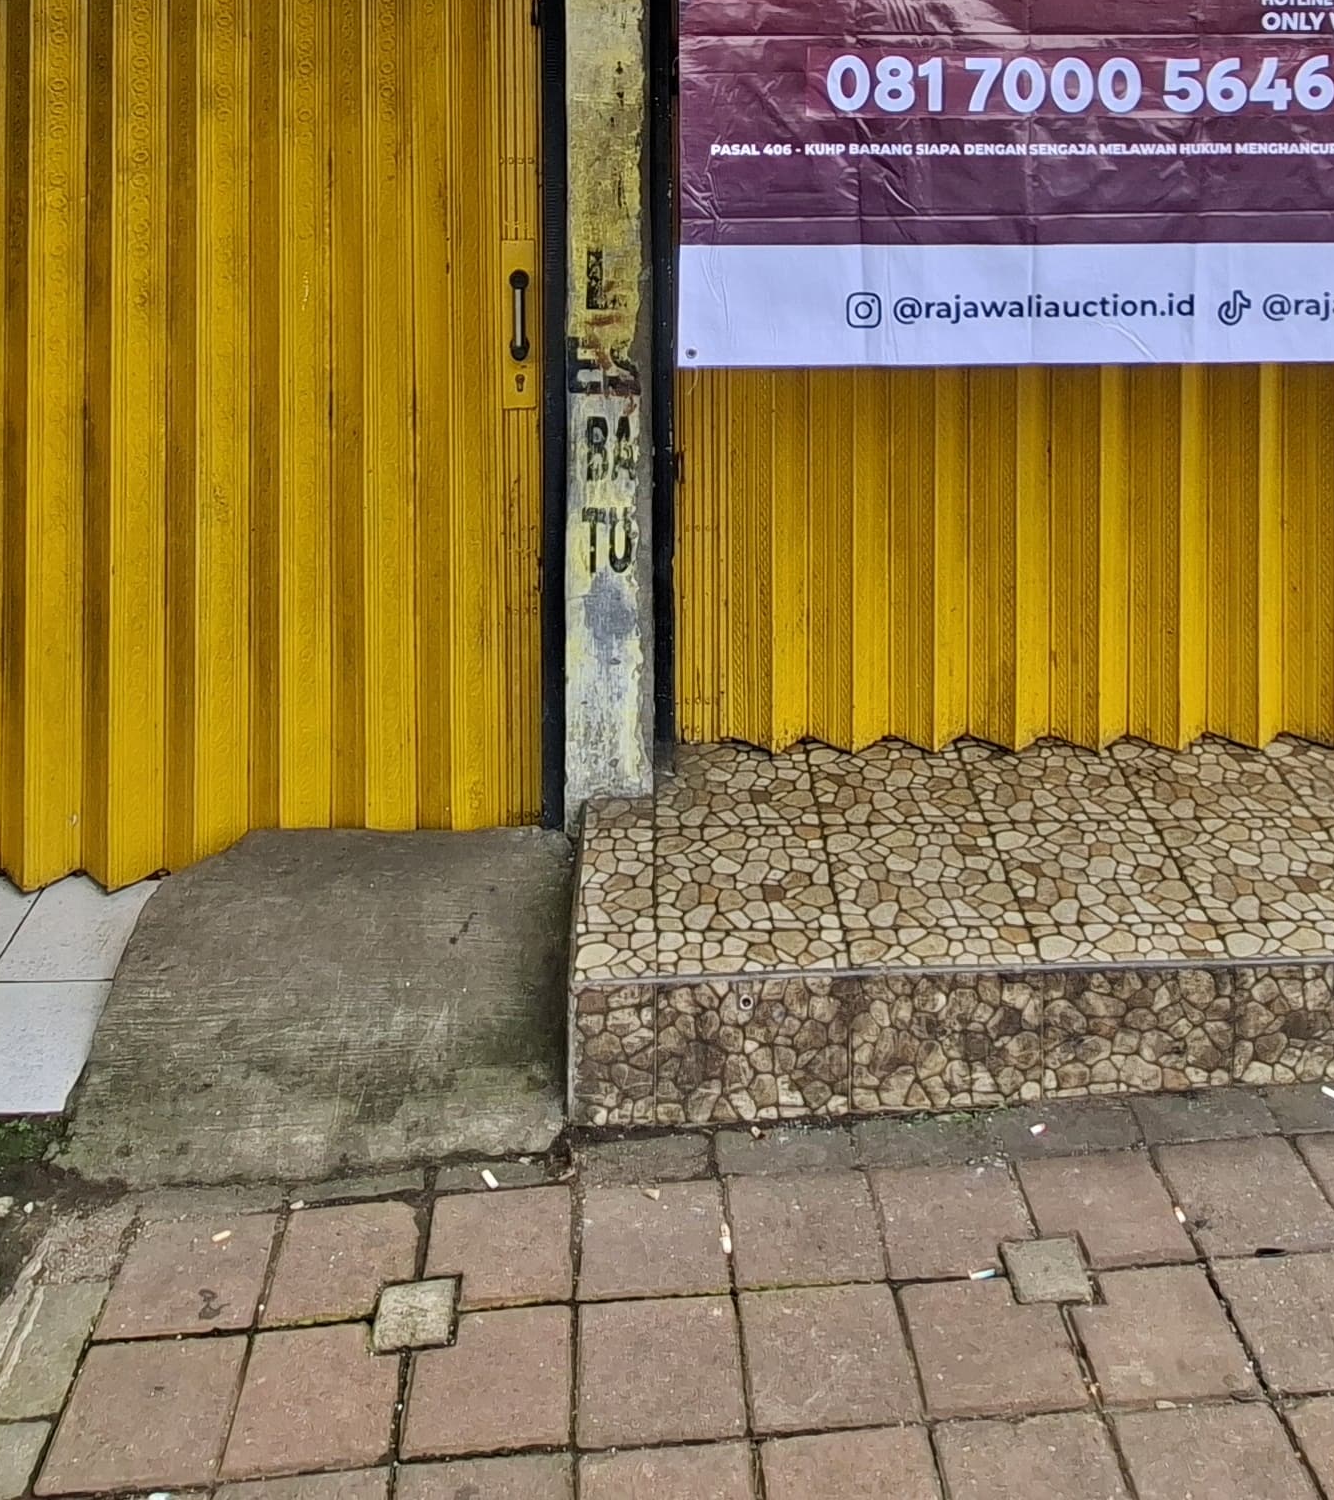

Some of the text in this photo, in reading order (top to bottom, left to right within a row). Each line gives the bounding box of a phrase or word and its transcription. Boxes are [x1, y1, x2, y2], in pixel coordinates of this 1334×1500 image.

[1262, 12, 1325, 31] ONLY
[826, 54, 945, 113] 081
[966, 56, 1142, 113] 7000
[710, 143, 761, 156] PASAL
[763, 143, 792, 156] 406
[804, 143, 846, 156] KUHP
[848, 143, 913, 156] BARANG
[915, 143, 961, 156] SIAPA
[963, 143, 1027, 156] DENGAN
[1028, 143, 1097, 156] SENGAJA
[1099, 143, 1177, 155] MELAWAN
[1179, 142, 1233, 155] HUKUM
[892, 292, 1195, 325] @rajawaliauction.id
